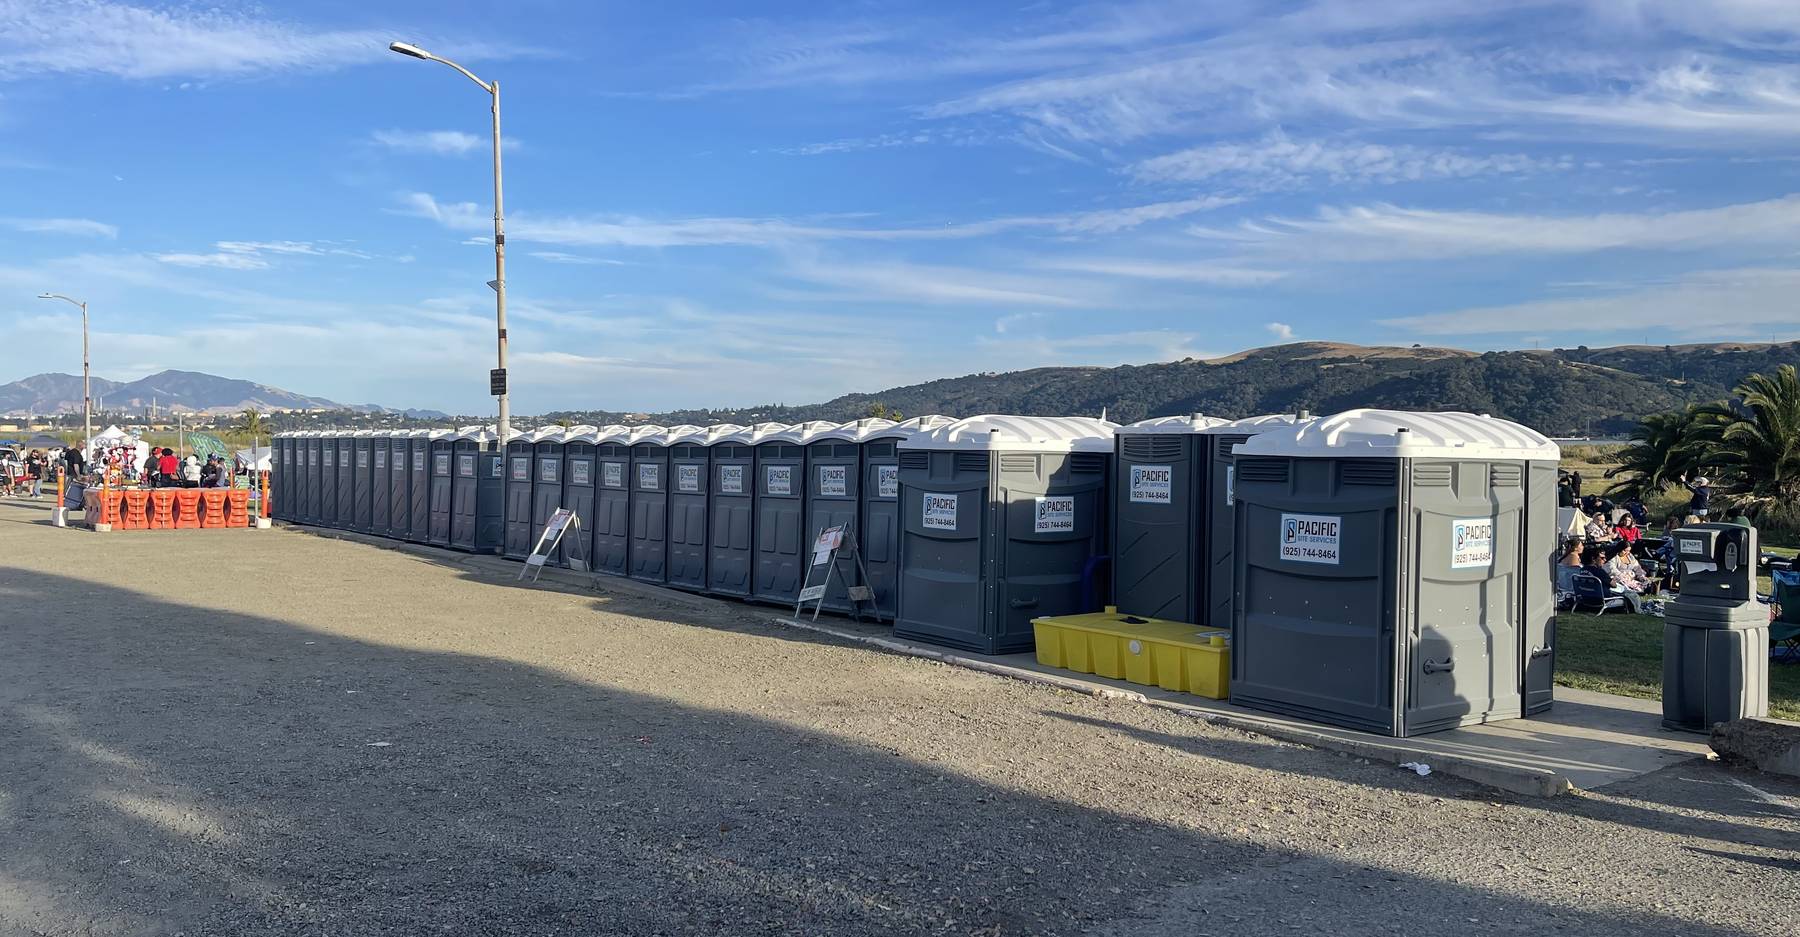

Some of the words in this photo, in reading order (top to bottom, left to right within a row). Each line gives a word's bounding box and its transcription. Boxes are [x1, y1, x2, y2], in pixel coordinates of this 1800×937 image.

[773, 470, 789, 479] PACIFIC
[827, 470, 844, 480] PACIFIC
[1141, 470, 1169, 482] PACIFIC
[1132, 490, 1144, 499] (925)
[1145, 491, 1169, 500] 744-8464
[932, 498, 956, 510] PACIFIC
[1047, 501, 1072, 512] PACIFIC
[935, 518, 955, 527] 744-8464
[1037, 521, 1050, 529] (925)
[1050, 521, 1072, 529] 744-8464
[1298, 520, 1337, 537] PACIFIC
[1466, 525, 1491, 539] PACIFIC
[1297, 535, 1308, 543] SITE
[1309, 536, 1337, 544] SERVICES
[1282, 546, 1301, 557] (925)
[1302, 547, 1337, 559] 744-8464
[1455, 553, 1468, 564] (925)
[1469, 552, 1491, 562] 744-8464
